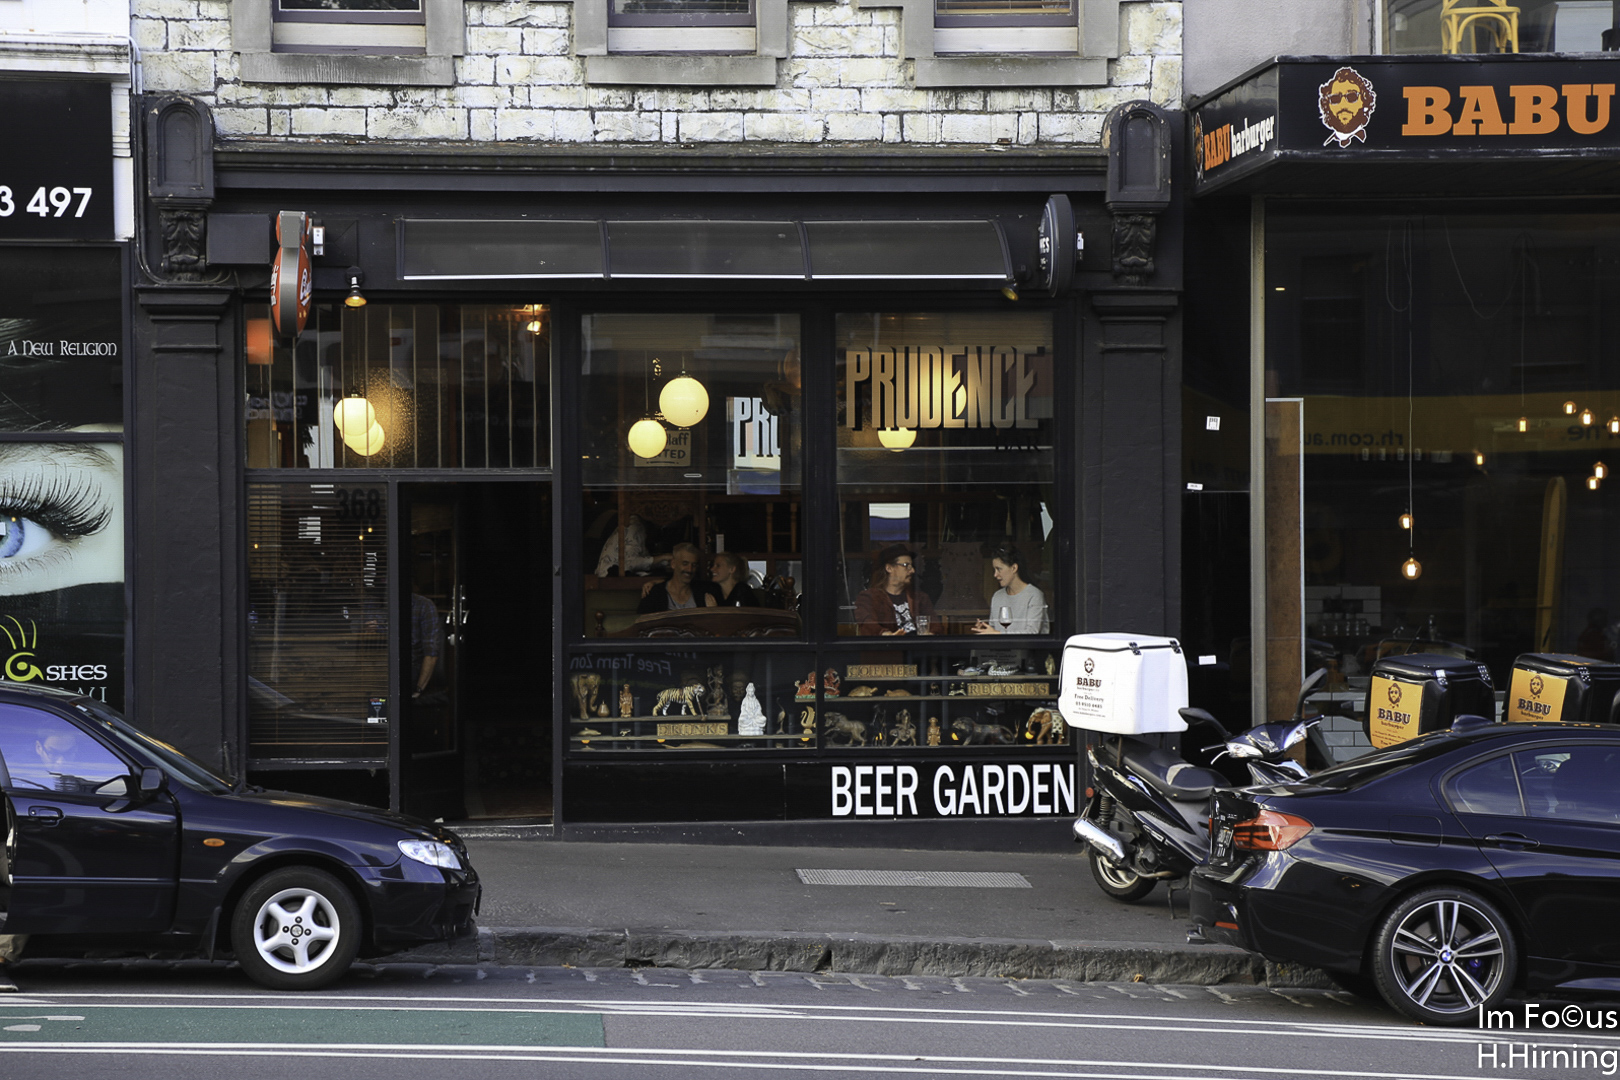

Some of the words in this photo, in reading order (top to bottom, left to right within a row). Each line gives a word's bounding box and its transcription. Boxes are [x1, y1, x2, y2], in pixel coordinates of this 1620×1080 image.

[1402, 83, 1616, 136] BABU
[1203, 123, 1230, 171] BABU
[1230, 115, 1275, 158] barburger
[26, 186, 92, 218] 497
[7, 340, 18, 356] A
[845, 346, 1045, 431] PRUDENCE
[335, 488, 380, 520] 368
[848, 664, 917, 677] COFFEE
[968, 683, 1049, 696] RECORDS
[1076, 677, 1102, 688] BABU
[1377, 707, 1412, 725] BABU
[1517, 697, 1552, 716] BABU
[658, 722, 728, 735] DRINKS
[831, 765, 919, 816] BEER
[933, 763, 1075, 816] GARDEN
